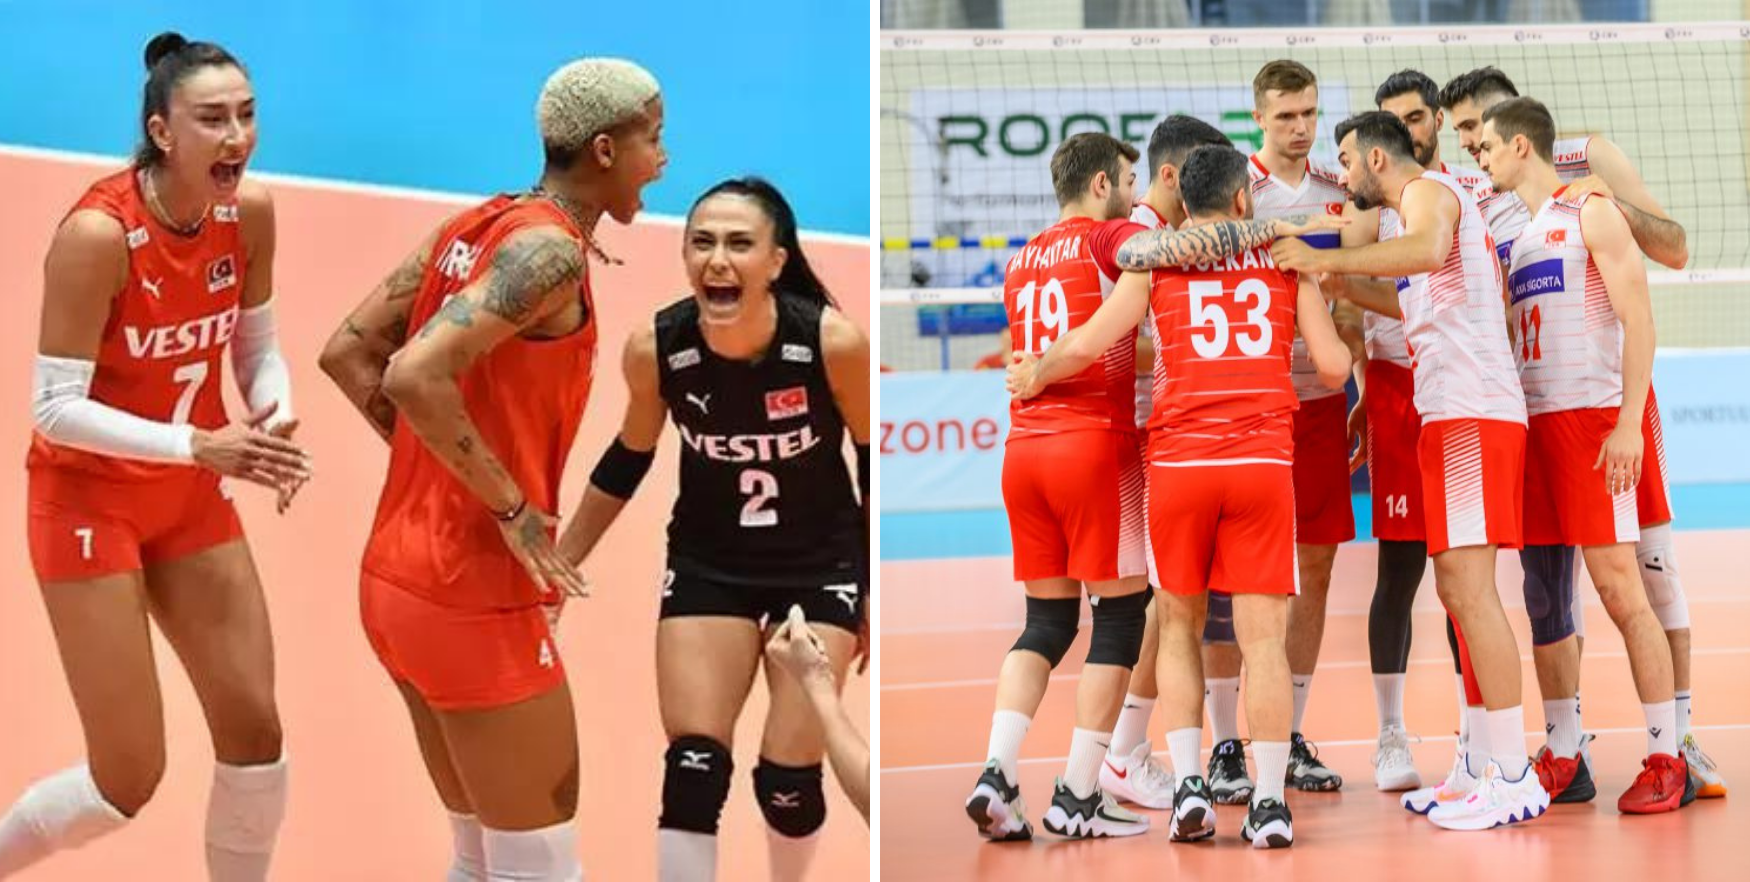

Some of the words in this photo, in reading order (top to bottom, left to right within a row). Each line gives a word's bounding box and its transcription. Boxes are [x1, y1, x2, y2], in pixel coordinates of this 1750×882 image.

[1016, 277, 1069, 354] 19
[1188, 278, 1273, 358] 53
[173, 361, 208, 425] 7
[680, 424, 820, 462] VESTEL
[880, 418, 998, 454] zone
[739, 468, 779, 527] 2
[1386, 494, 1408, 518] 14
